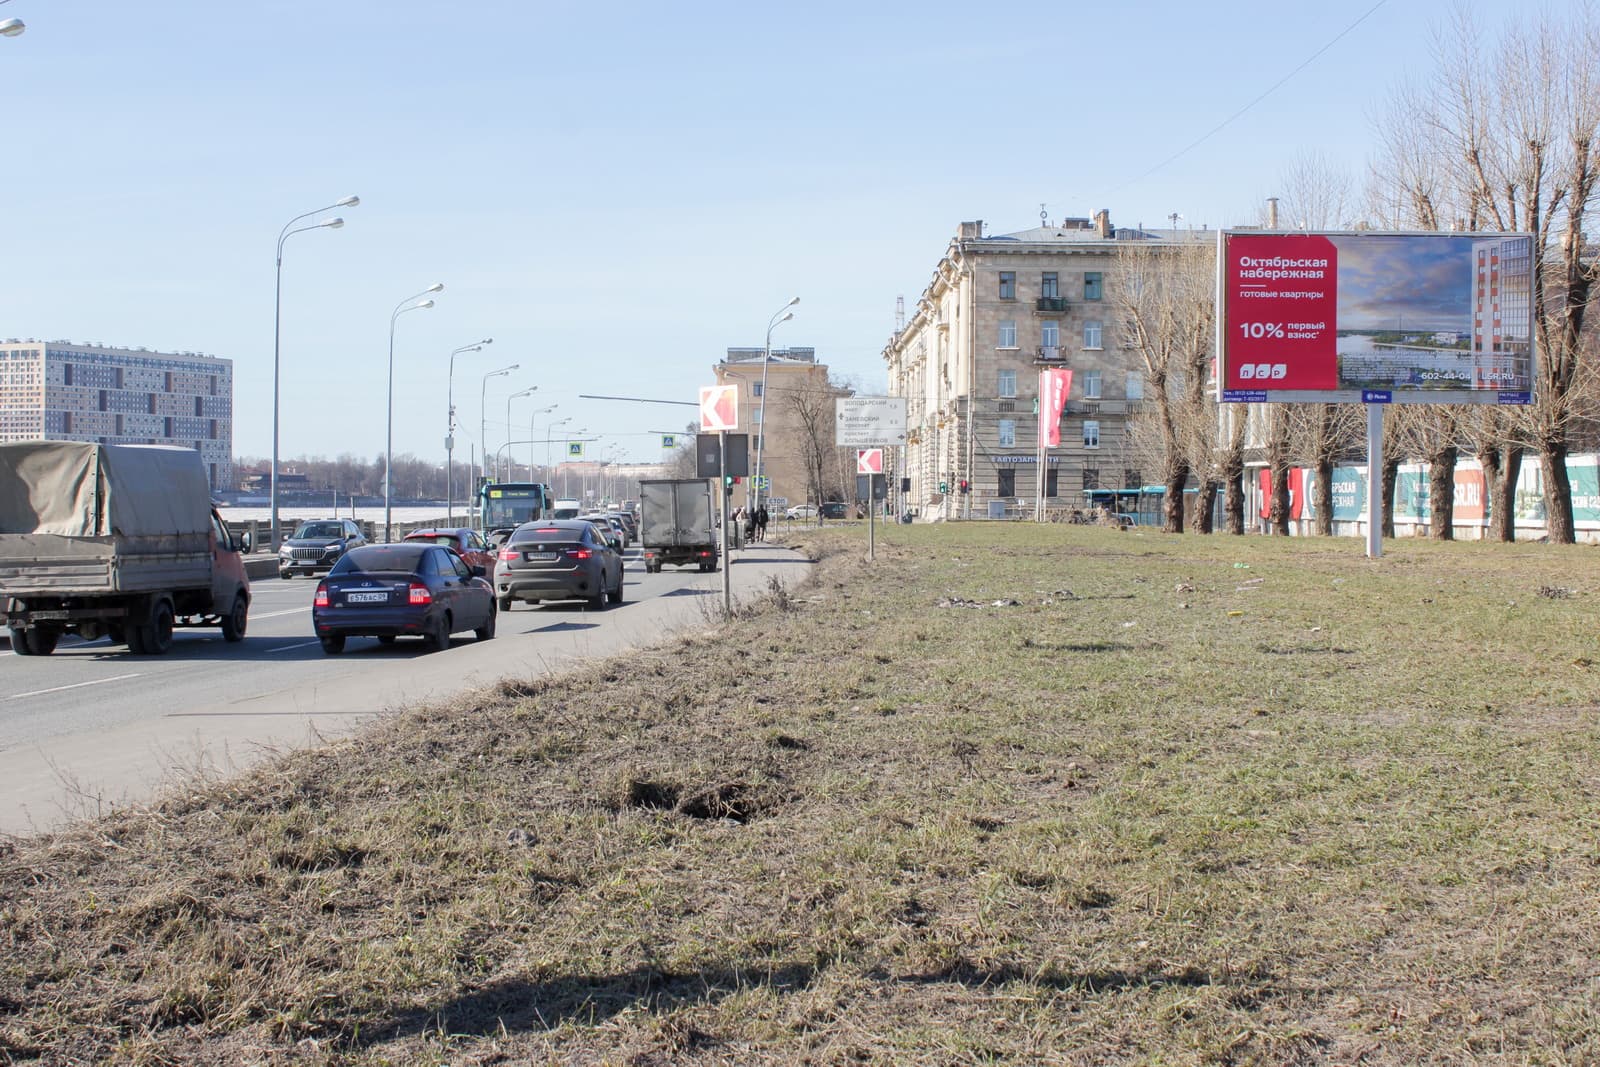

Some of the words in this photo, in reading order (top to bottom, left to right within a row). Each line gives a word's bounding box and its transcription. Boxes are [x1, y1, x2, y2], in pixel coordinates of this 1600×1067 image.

[1240, 256, 1328, 269] Октябрьская
[1240, 268, 1324, 280] набережная
[1280, 291, 1324, 300] квартиры
[1240, 322, 1284, 338] 10%
[1287, 321, 1325, 331] первый
[1454, 483, 1480, 507] SR.RU
